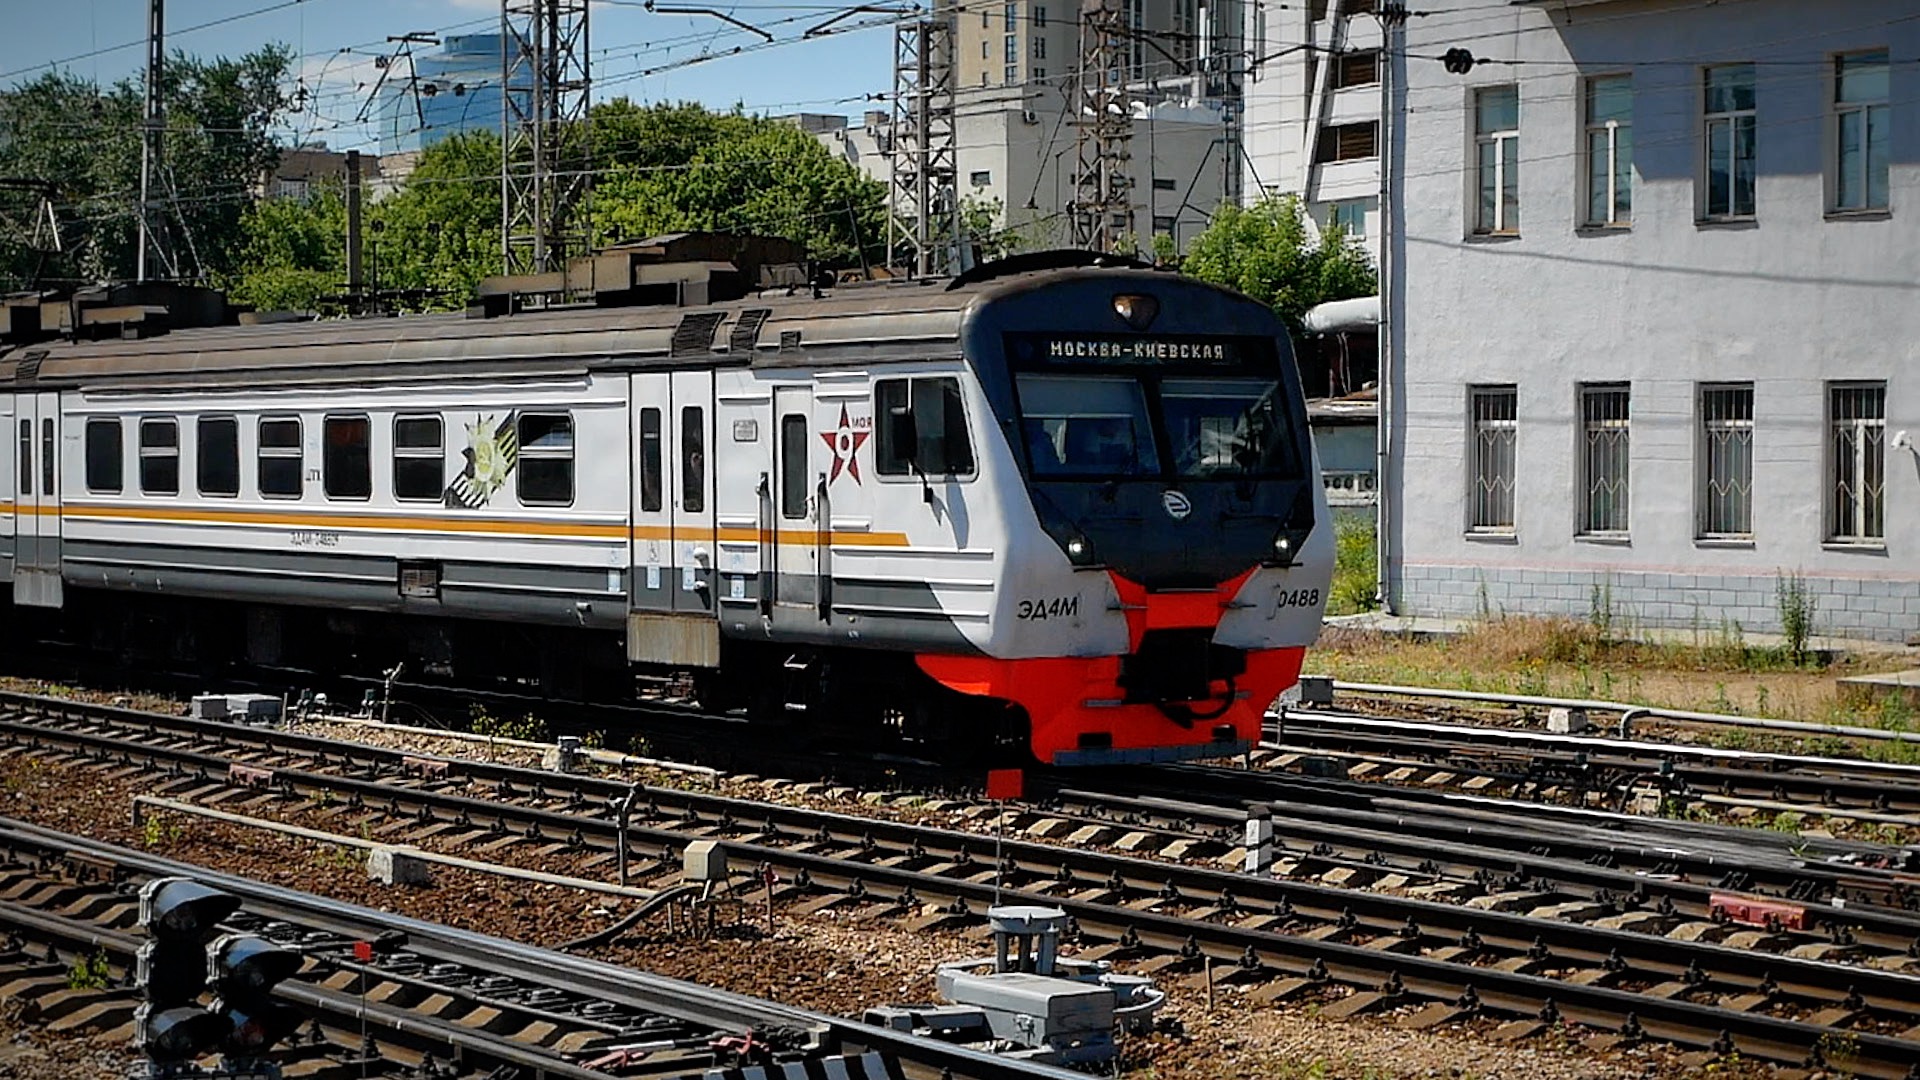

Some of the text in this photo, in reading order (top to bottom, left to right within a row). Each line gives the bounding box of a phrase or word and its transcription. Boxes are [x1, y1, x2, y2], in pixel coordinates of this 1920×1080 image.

[1050, 341, 1223, 359] МОСКВА-КИЕВСКАЯ
[1277, 587, 1320, 608] 0488
[1017, 596, 1078, 621] ЭД4М
